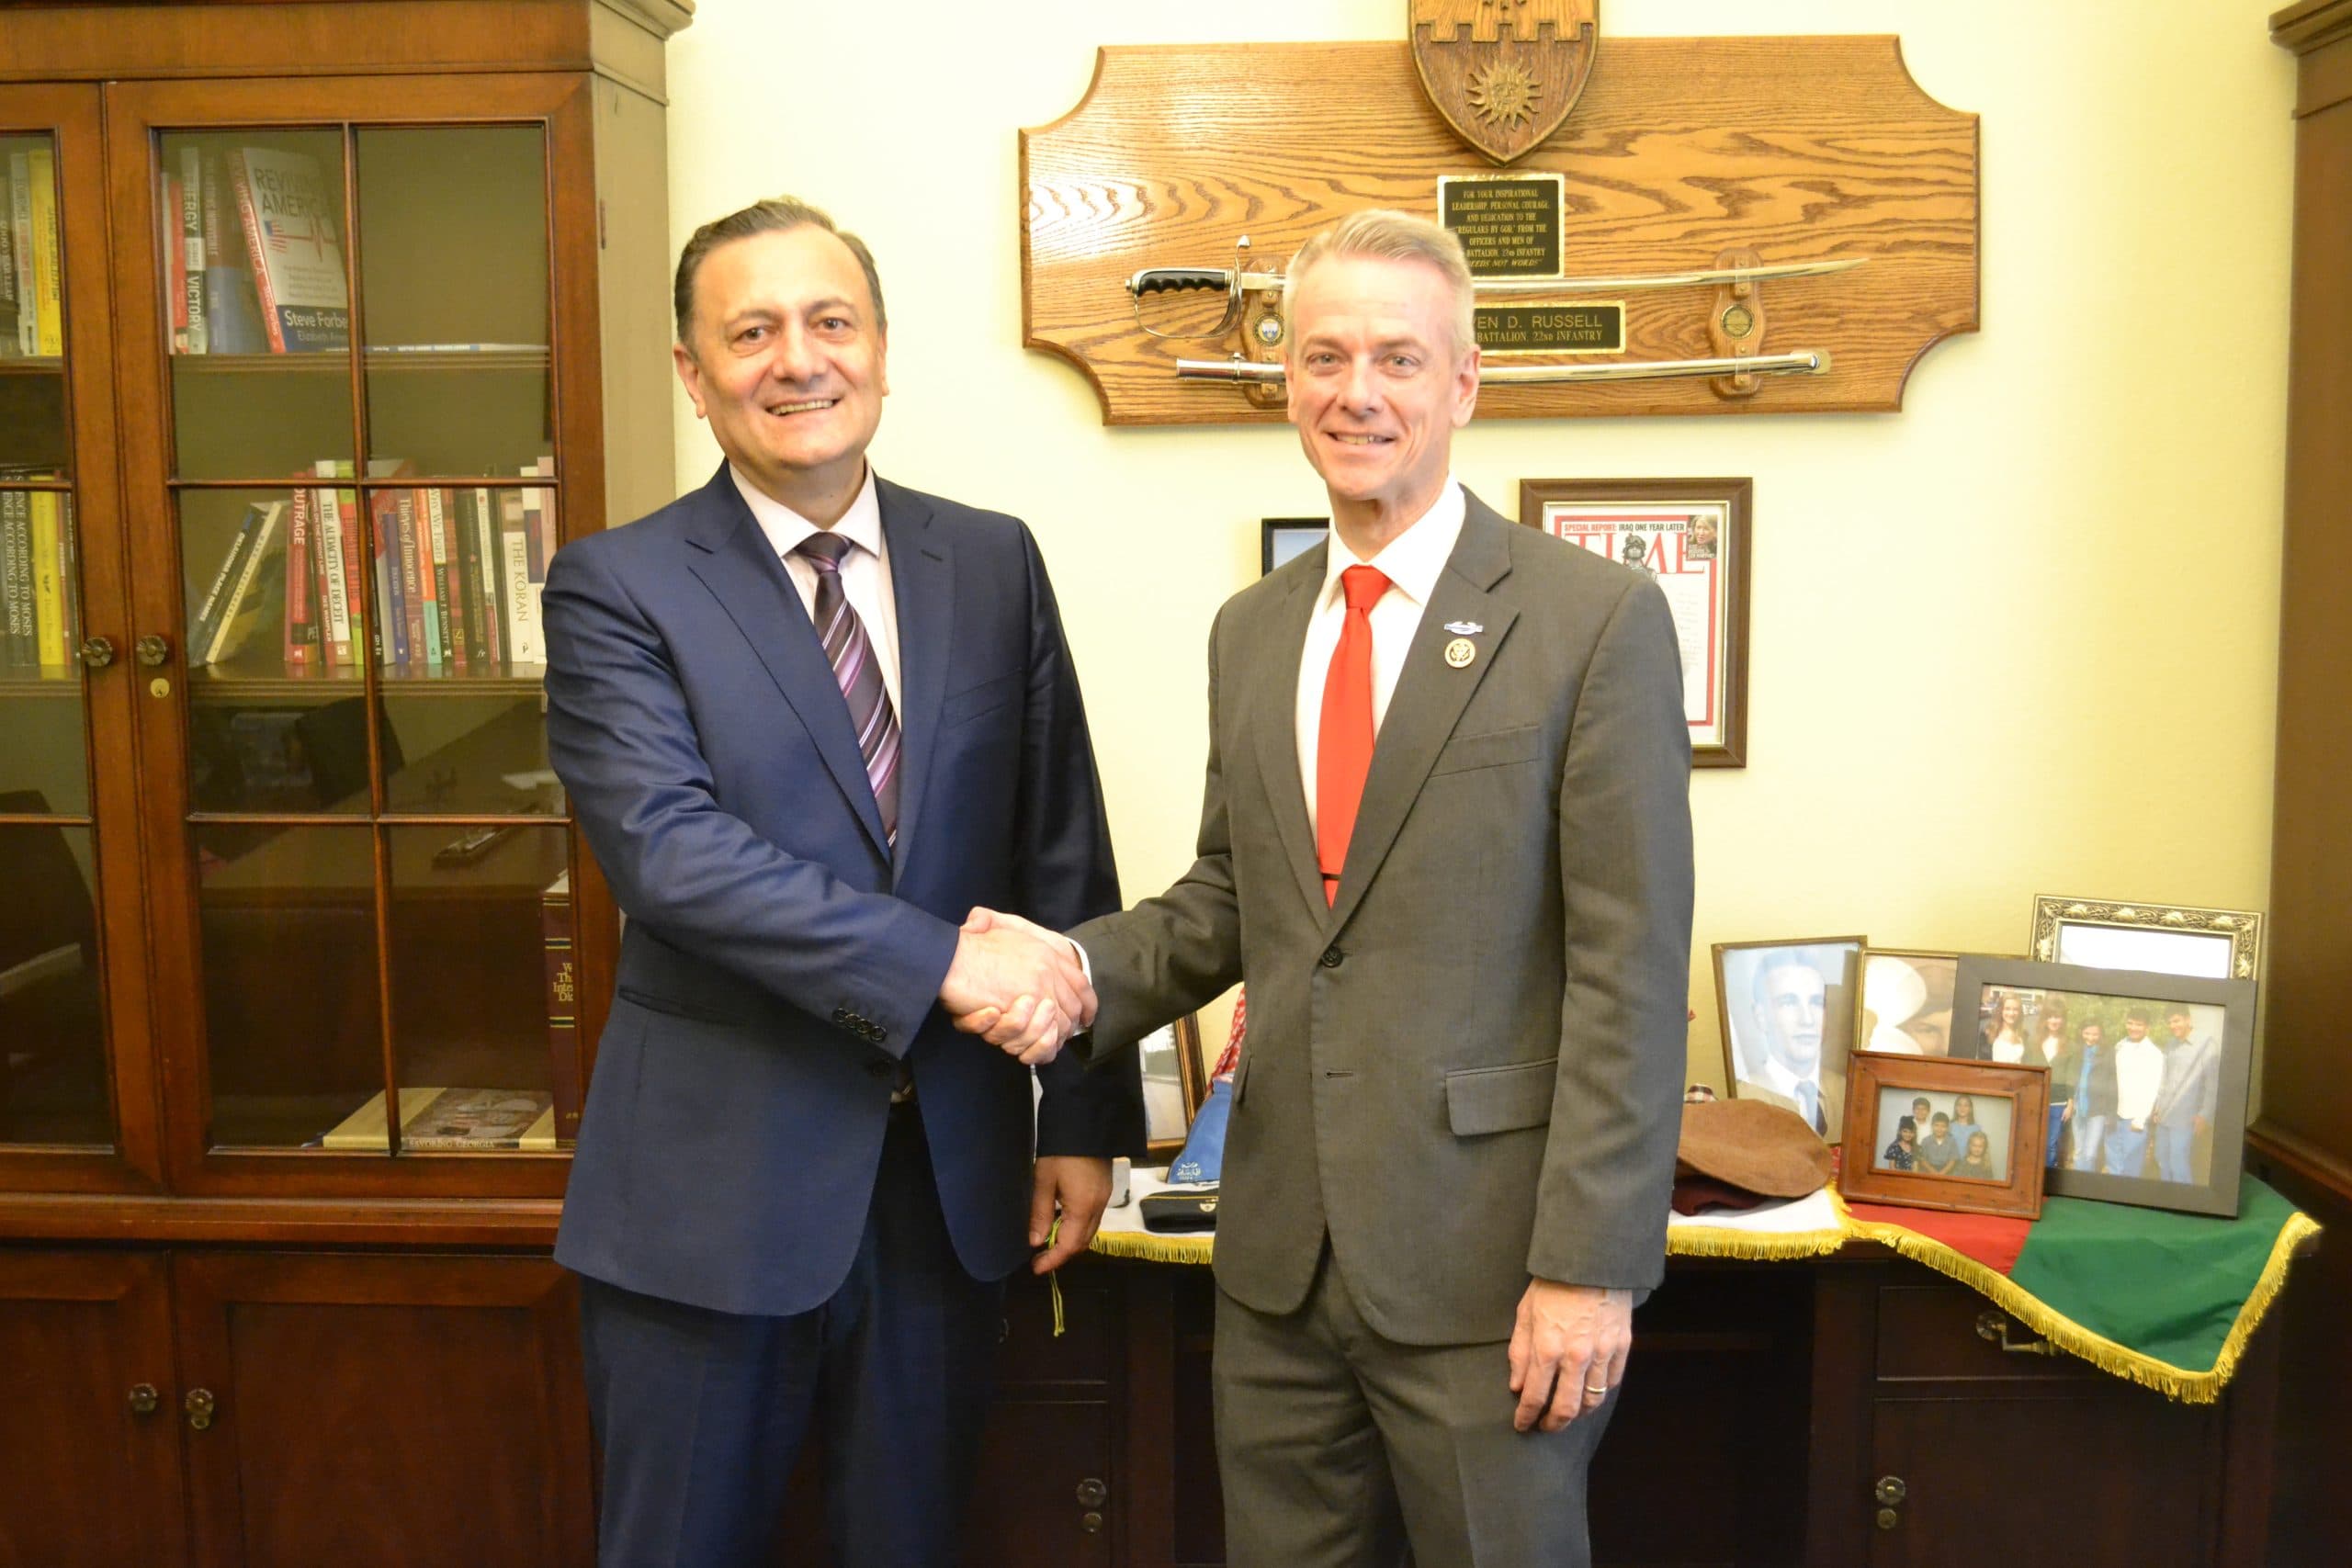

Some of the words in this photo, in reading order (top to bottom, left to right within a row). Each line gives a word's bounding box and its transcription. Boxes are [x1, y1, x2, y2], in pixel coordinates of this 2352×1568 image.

[1463, 189, 1475, 198] FOR
[1477, 189, 1493, 198] YOUR
[1495, 188, 1539, 197] INSPIRATIONAL
[1466, 213, 1479, 221] AND
[1480, 212, 1514, 221] DEDICATION
[1516, 212, 1524, 220] TO
[1525, 212, 1537, 220] THE
[1518, 224, 1533, 232] FROM
[1535, 223, 1547, 232] THE
[243, 218, 265, 276] AMERICA
[1469, 237, 1497, 245] OFFICERS
[1498, 236, 1511, 245] AND
[1511, 236, 1525, 245] MEN
[1525, 236, 1534, 244] OF
[1516, 248, 1546, 256] INFANTRY
[1470, 259, 1491, 267] EEDS
[187, 276, 201, 332] VICTORY
[284, 310, 316, 326] Steve
[317, 311, 347, 329] Forbe
[1508, 315, 1522, 329] D.
[1532, 314, 1603, 329] RUSSELL
[1556, 330, 1602, 341] INFANTRY
[322, 502, 334, 522] THE
[399, 499, 413, 532] Thieves
[401, 532, 414, 546] of
[1565, 524, 1589, 532] SPECIAL
[1591, 524, 1617, 532] REPORT:
[1619, 524, 1634, 533] IRAQ
[1634, 524, 1647, 532] ONE
[1648, 524, 1665, 532] YEAR
[1666, 524, 1685, 532] LATER
[5, 520, 17, 581] ACCORDING
[17, 521, 29, 582] ACCORDING
[315, 538, 324, 560] FRONT
[323, 523, 339, 570] AUDACITY
[512, 538, 525, 567] THE
[329, 571, 339, 587] OF
[403, 544, 417, 593] Innocence
[8, 583, 17, 599] TO
[20, 584, 30, 601] TO
[436, 568, 447, 601] WILLIAM
[331, 589, 344, 624] DECEIT
[514, 570, 529, 622] KORAN
[8, 601, 19, 635] MOSES
[21, 603, 32, 637] MOSES
[440, 610, 450, 644] BENNETT
